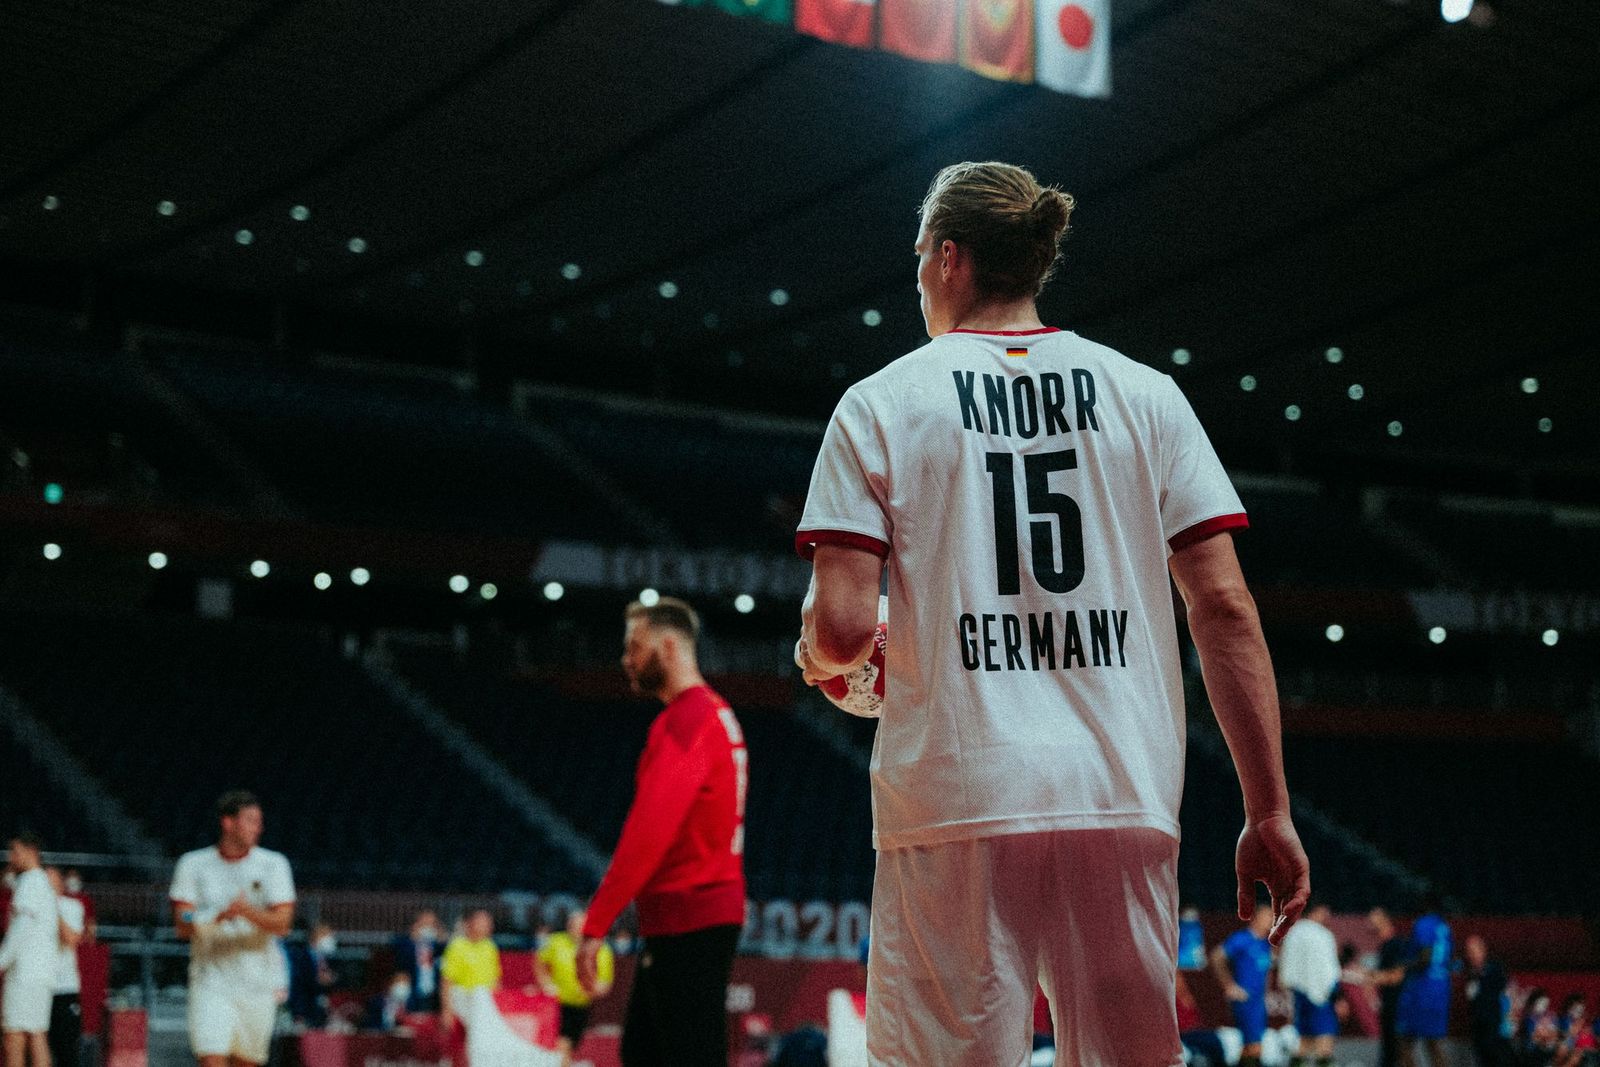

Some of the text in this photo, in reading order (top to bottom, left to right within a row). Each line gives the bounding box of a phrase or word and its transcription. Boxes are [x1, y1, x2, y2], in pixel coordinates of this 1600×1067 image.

[952, 368, 1100, 440] KNORR
[985, 448, 1086, 596] 15
[958, 609, 1128, 672] GERMANY
